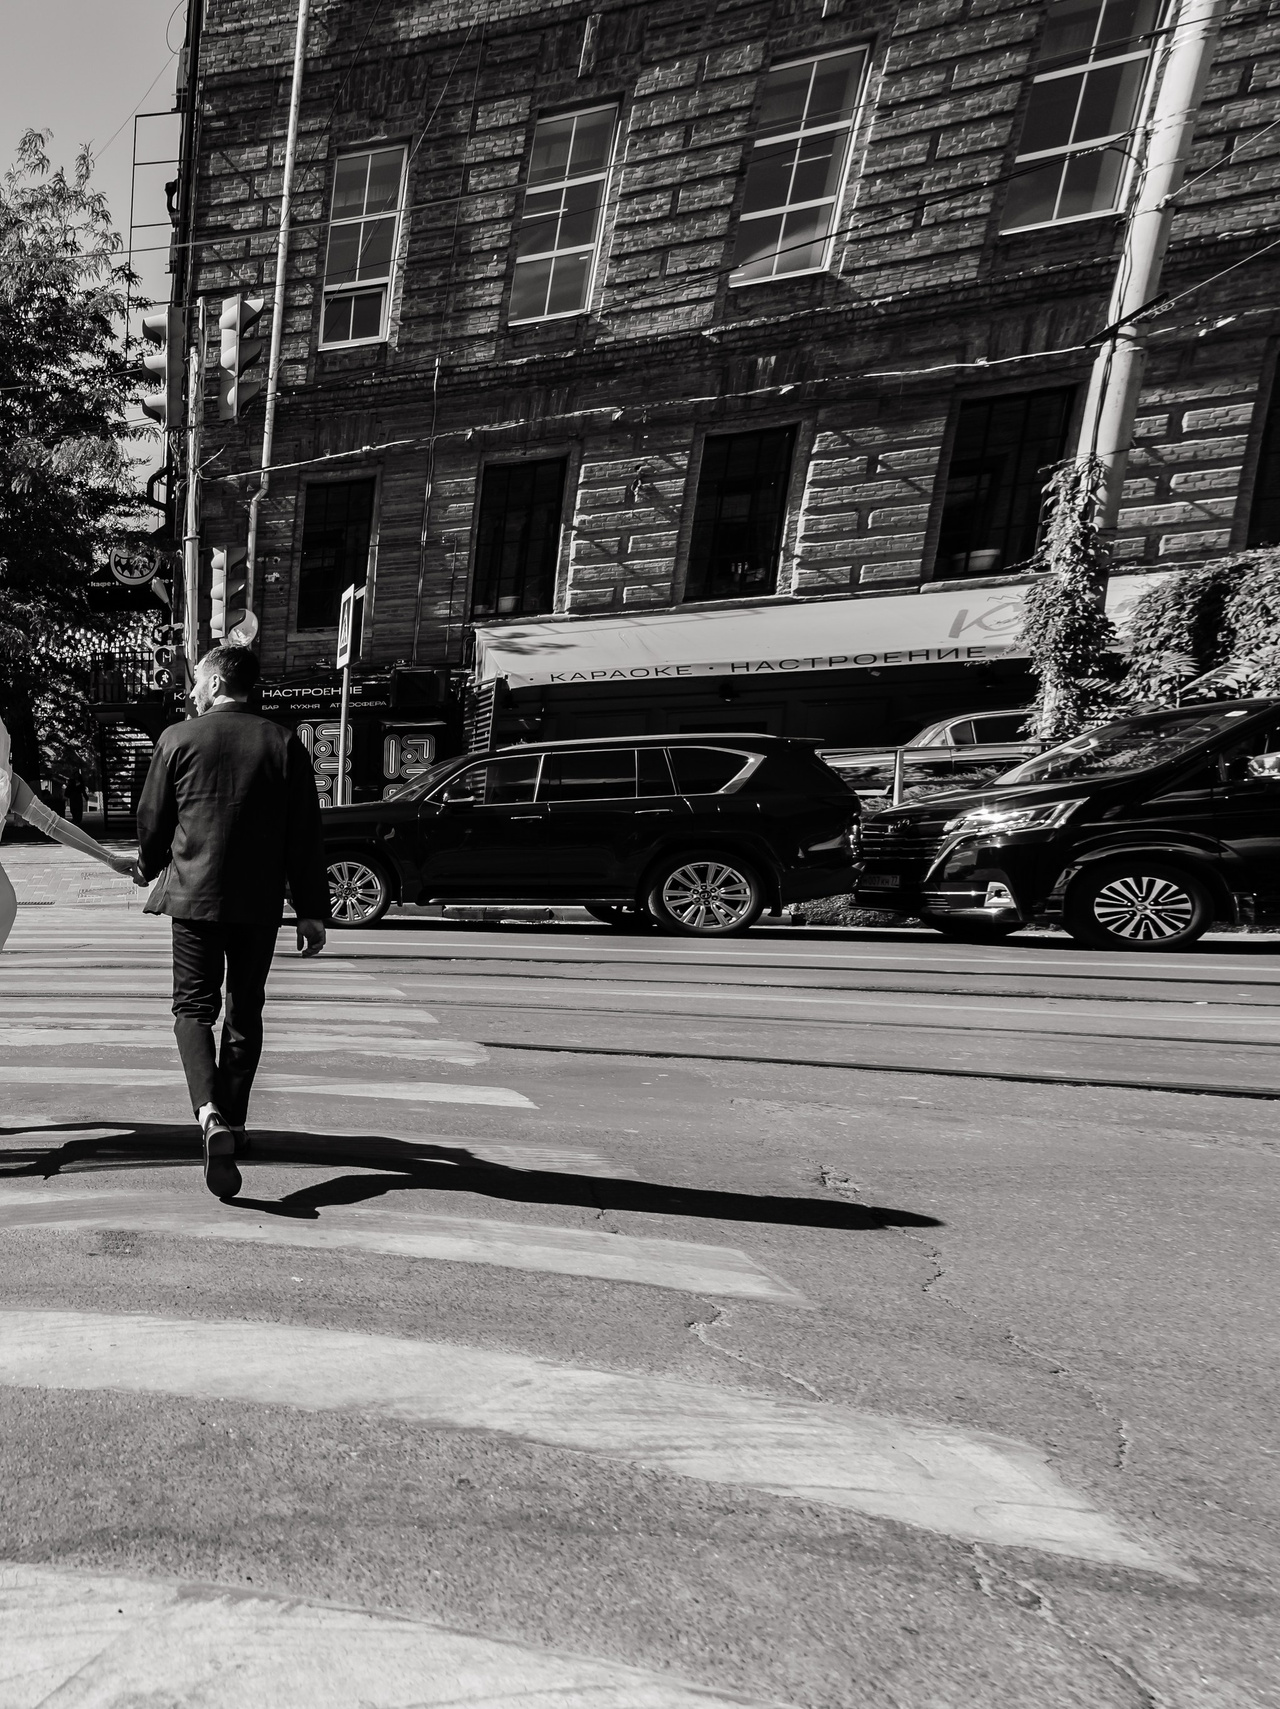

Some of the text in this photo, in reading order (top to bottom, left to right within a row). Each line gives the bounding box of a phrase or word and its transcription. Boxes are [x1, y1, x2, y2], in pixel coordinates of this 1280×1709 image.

[550, 645, 988, 683] КАРАОКЕ НАСТРОЕНИЕ
[329, 700, 387, 709] АТОСФЕРА
